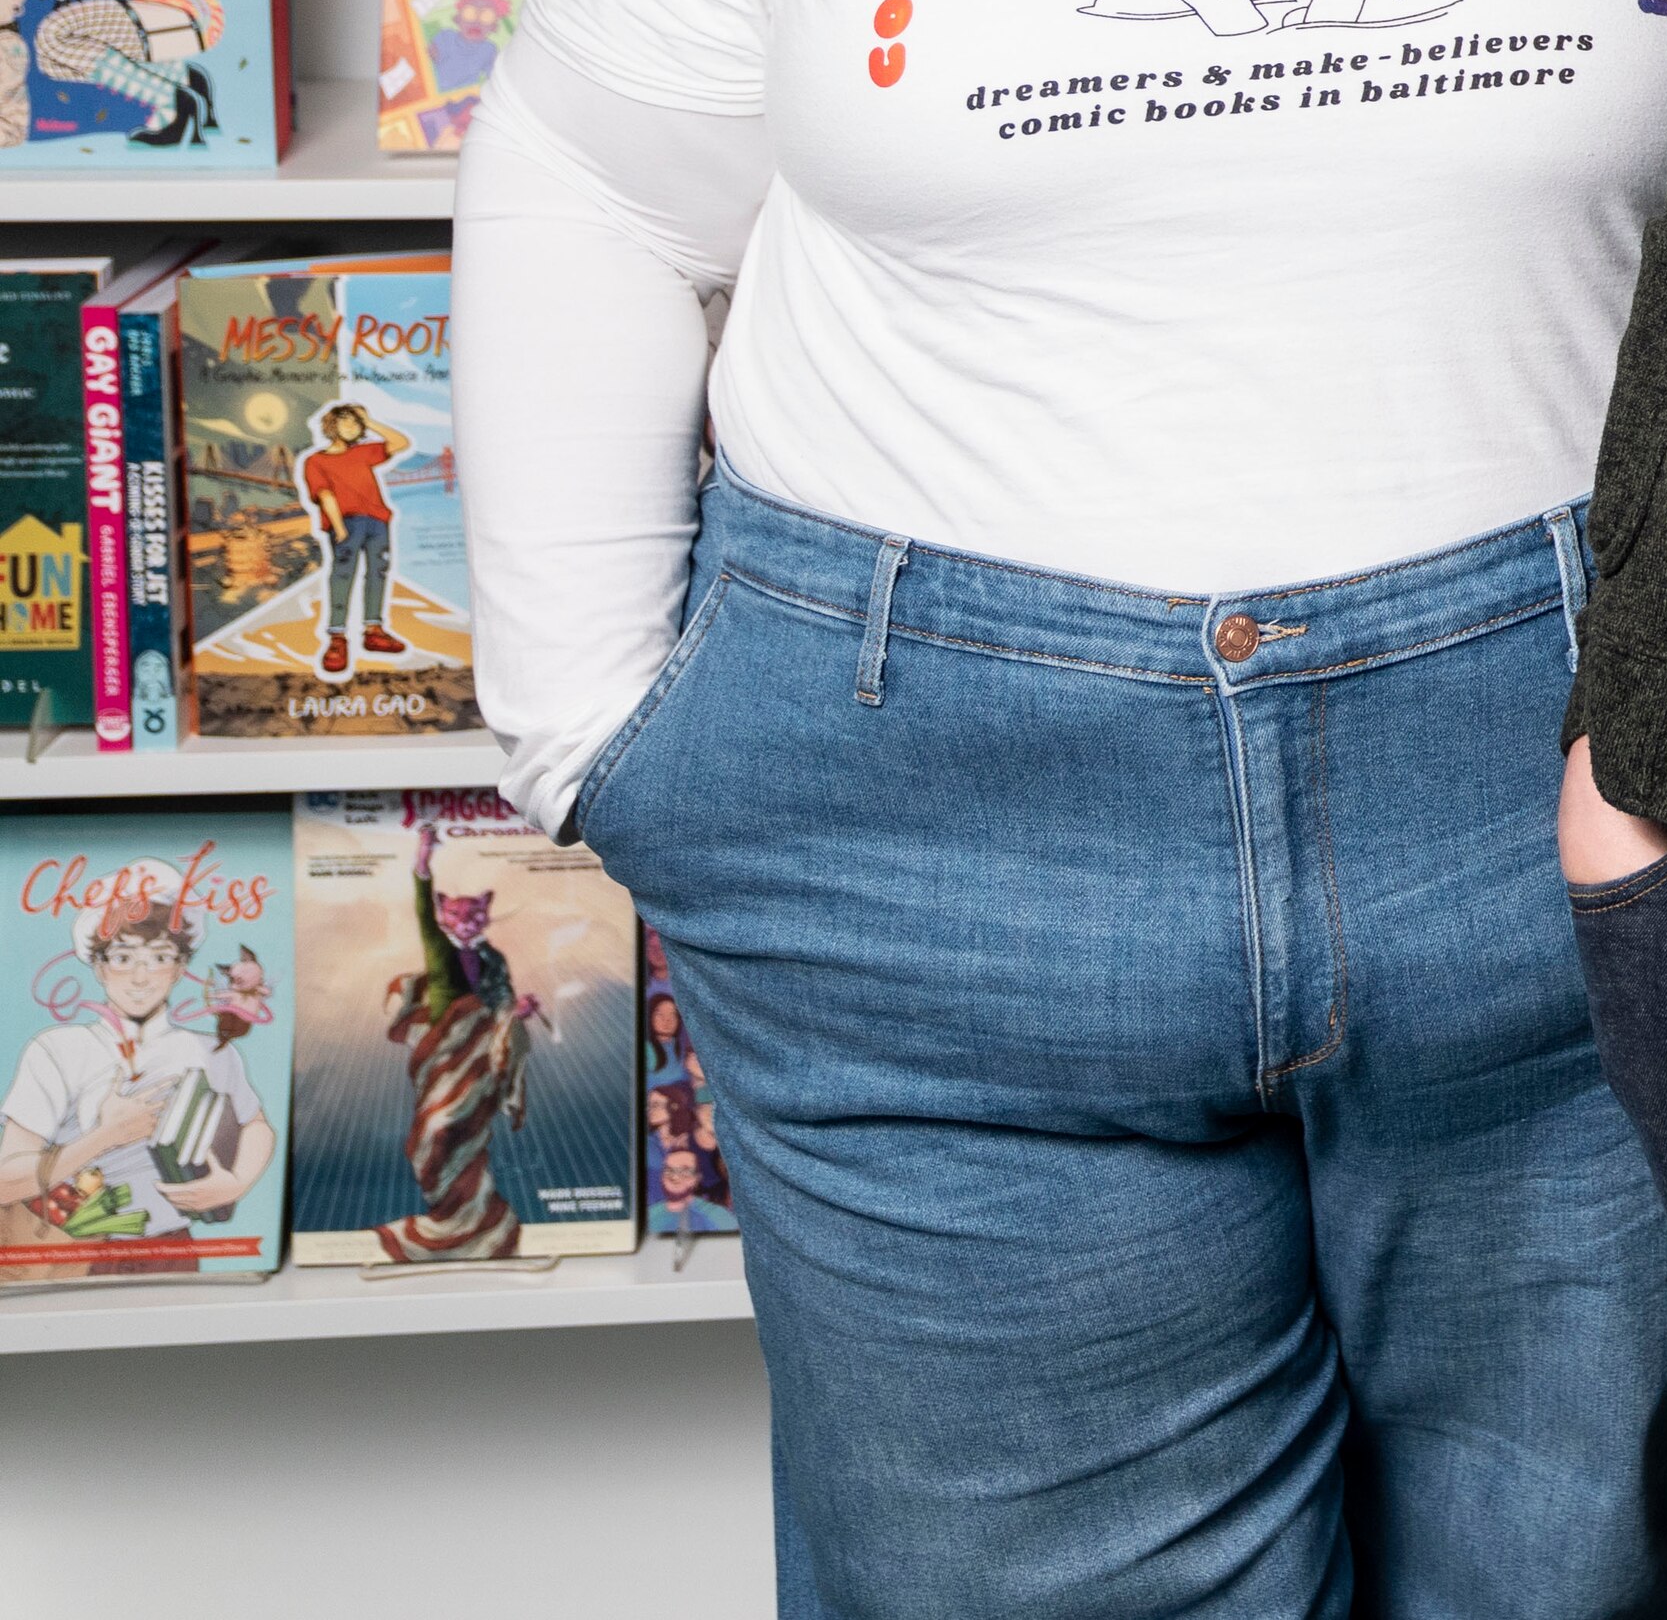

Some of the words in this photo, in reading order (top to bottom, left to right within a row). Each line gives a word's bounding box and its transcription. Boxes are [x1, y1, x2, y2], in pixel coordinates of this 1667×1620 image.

[966, 60, 1184, 111] dreamers
[1201, 63, 1236, 86] &
[998, 101, 1126, 140] comic
[1144, 86, 1282, 123] books
[1299, 79, 1343, 110] in
[1359, 62, 1577, 105] baltimore
[84, 325, 119, 395] GAY
[218, 312, 343, 364] MESSY
[351, 313, 450, 359] ROOT
[142, 461, 167, 531] KISSES
[144, 534, 168, 568] FOR
[146, 570, 169, 605] JET
[288, 693, 367, 719] LAURA
[372, 692, 427, 718] GAO
[20, 853, 165, 941] Chef's
[168, 838, 279, 934] Kiss
